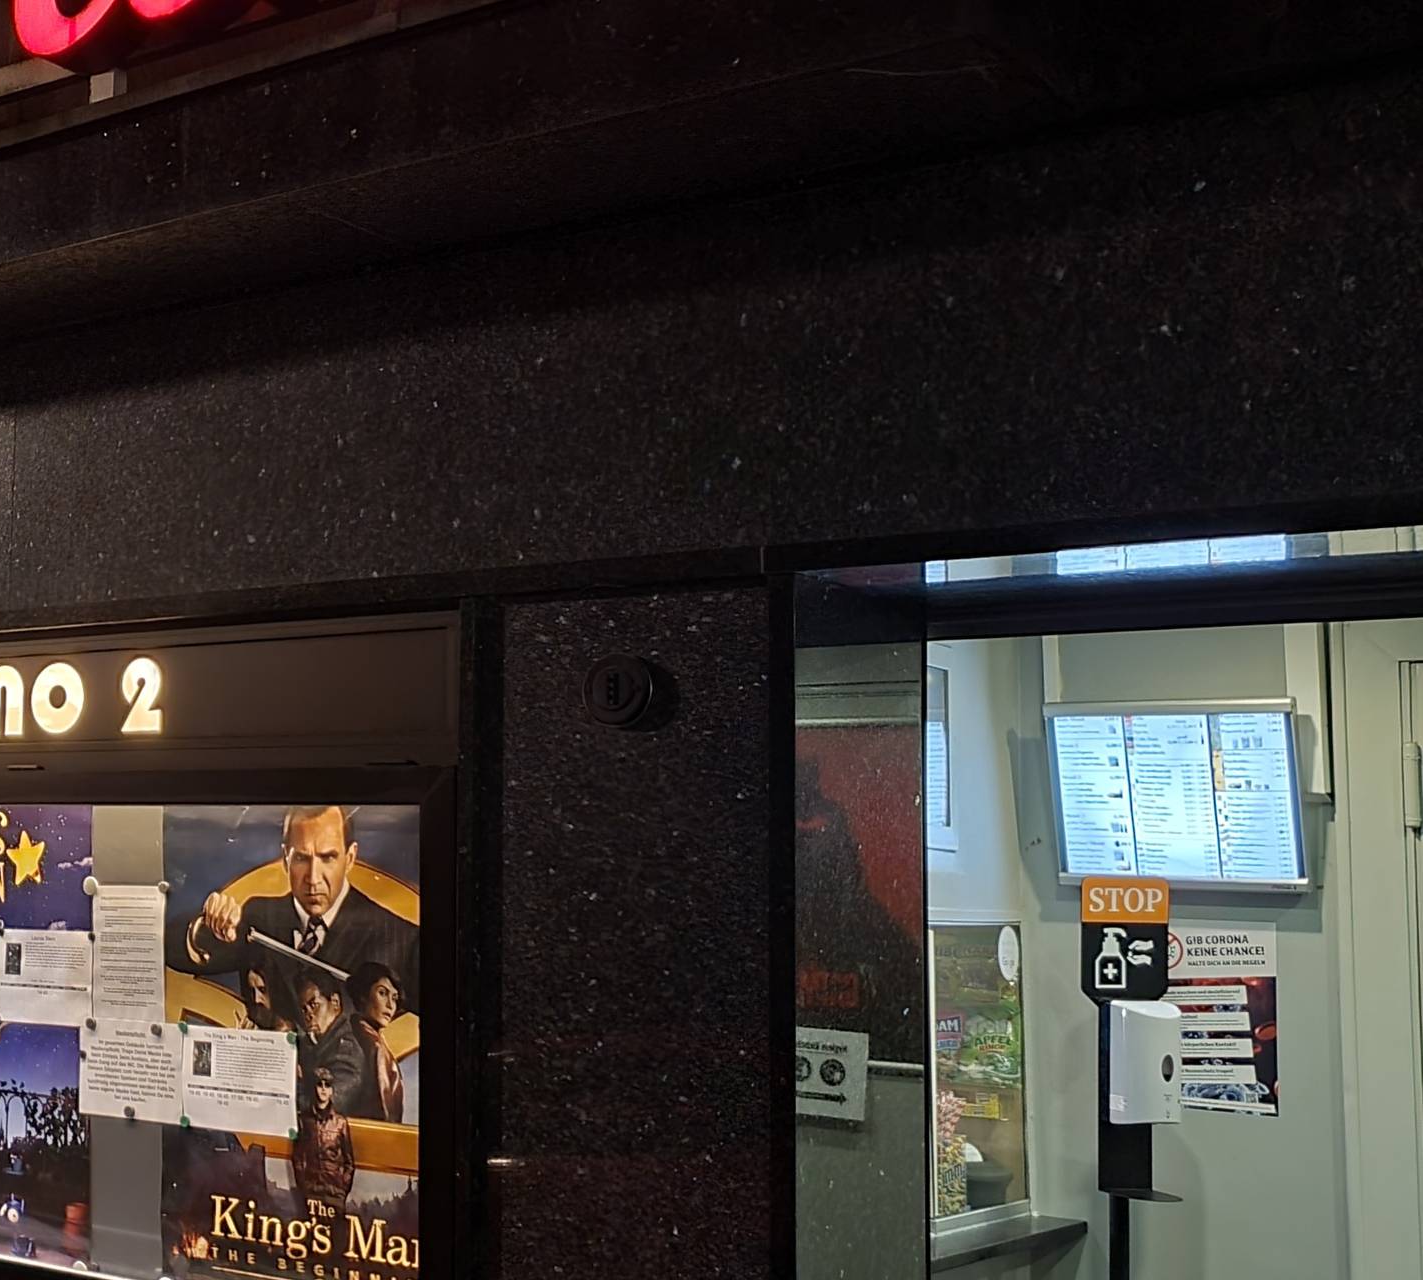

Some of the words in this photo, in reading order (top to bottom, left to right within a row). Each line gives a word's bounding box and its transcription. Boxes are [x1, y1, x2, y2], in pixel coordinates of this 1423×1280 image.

[121, 657, 162, 734] 2
[1088, 887, 1163, 912] STOP
[1185, 936, 1203, 945] GIB
[1205, 935, 1249, 945] CORONA
[1186, 947, 1218, 957] KEINE
[1219, 946, 1265, 956] CHANCE!
[935, 1019, 959, 1032] AM
[307, 1199, 336, 1218] The
[210, 1195, 332, 1259] King's
[211, 1245, 257, 1264] THE
[277, 1257, 417, 1280] BEGINN
